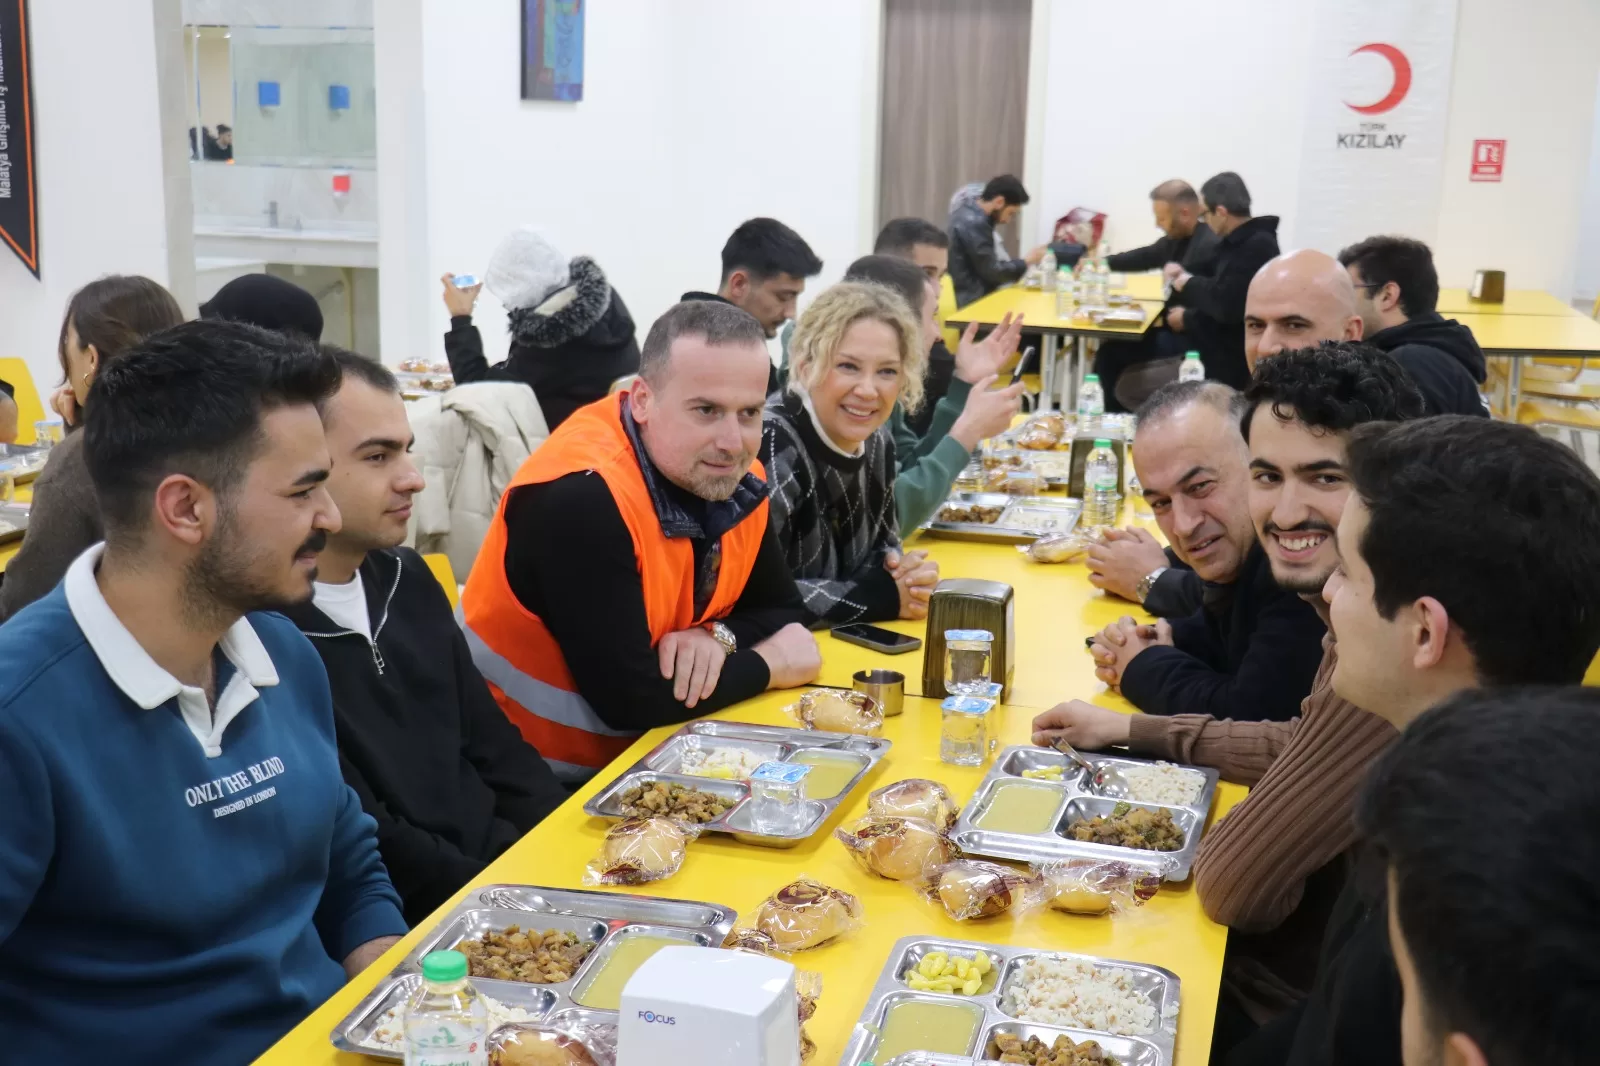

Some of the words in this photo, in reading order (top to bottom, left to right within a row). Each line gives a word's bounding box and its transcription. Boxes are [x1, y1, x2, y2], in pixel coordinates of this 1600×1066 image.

[1337, 133, 1407, 149] KIZILAY
[0, 153, 12, 199] Malatya
[185, 779, 225, 808] ONLY
[221, 771, 252, 795] THE
[247, 756, 285, 784] BLIND
[213, 799, 246, 819] DESIGNED
[244, 796, 254, 807] IN
[253, 786, 277, 804] LONDON
[638, 1010, 676, 1025] FOCUS
